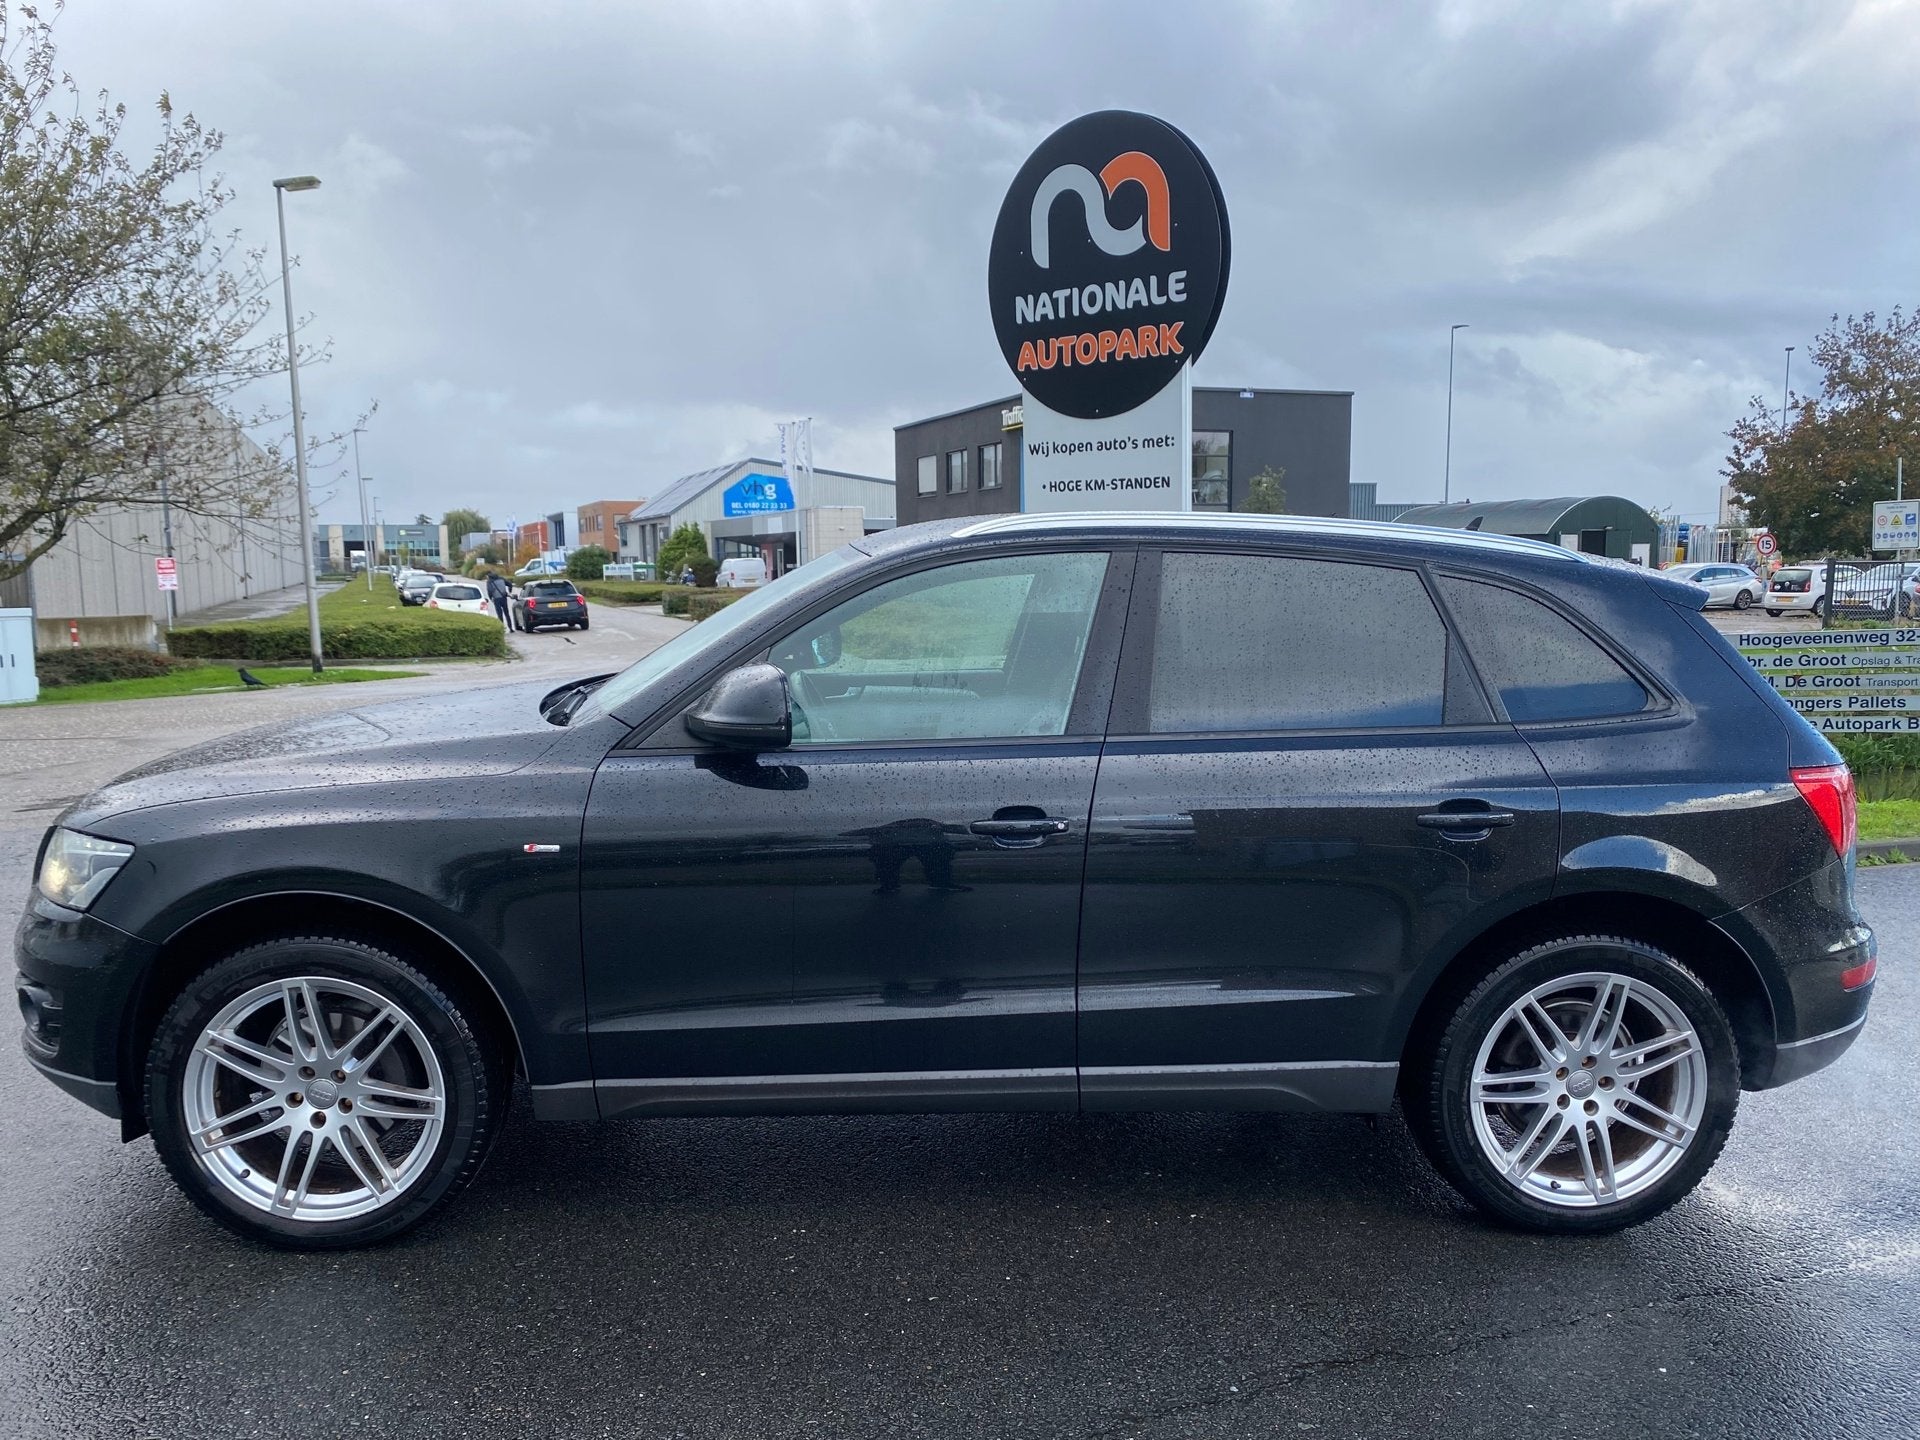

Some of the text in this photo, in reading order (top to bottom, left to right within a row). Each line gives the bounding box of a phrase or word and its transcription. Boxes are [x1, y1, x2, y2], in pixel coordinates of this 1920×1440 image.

[1015, 270, 1187, 324] NATIONALE
[1017, 321, 1184, 371] AUTOPARK
[1029, 434, 1175, 457] Wij kopen auto's met:
[742, 480, 777, 499] vhg
[1050, 476, 1171, 492] HOGE KM-STANDEN
[1761, 540, 1772, 549] 15
[1739, 632, 1889, 648] Hoogeveenenweg
[1773, 655, 1793, 667] de
[1798, 654, 1847, 666] Groot
[1851, 656, 1890, 667] Opslag
[1894, 656, 1903, 665] &
[1785, 675, 1807, 687] De
[1812, 675, 1861, 687] Groot
[1866, 677, 1918, 689] Transport
[1849, 696, 1906, 708] Pallets
[1822, 717, 1901, 732] Autopark
